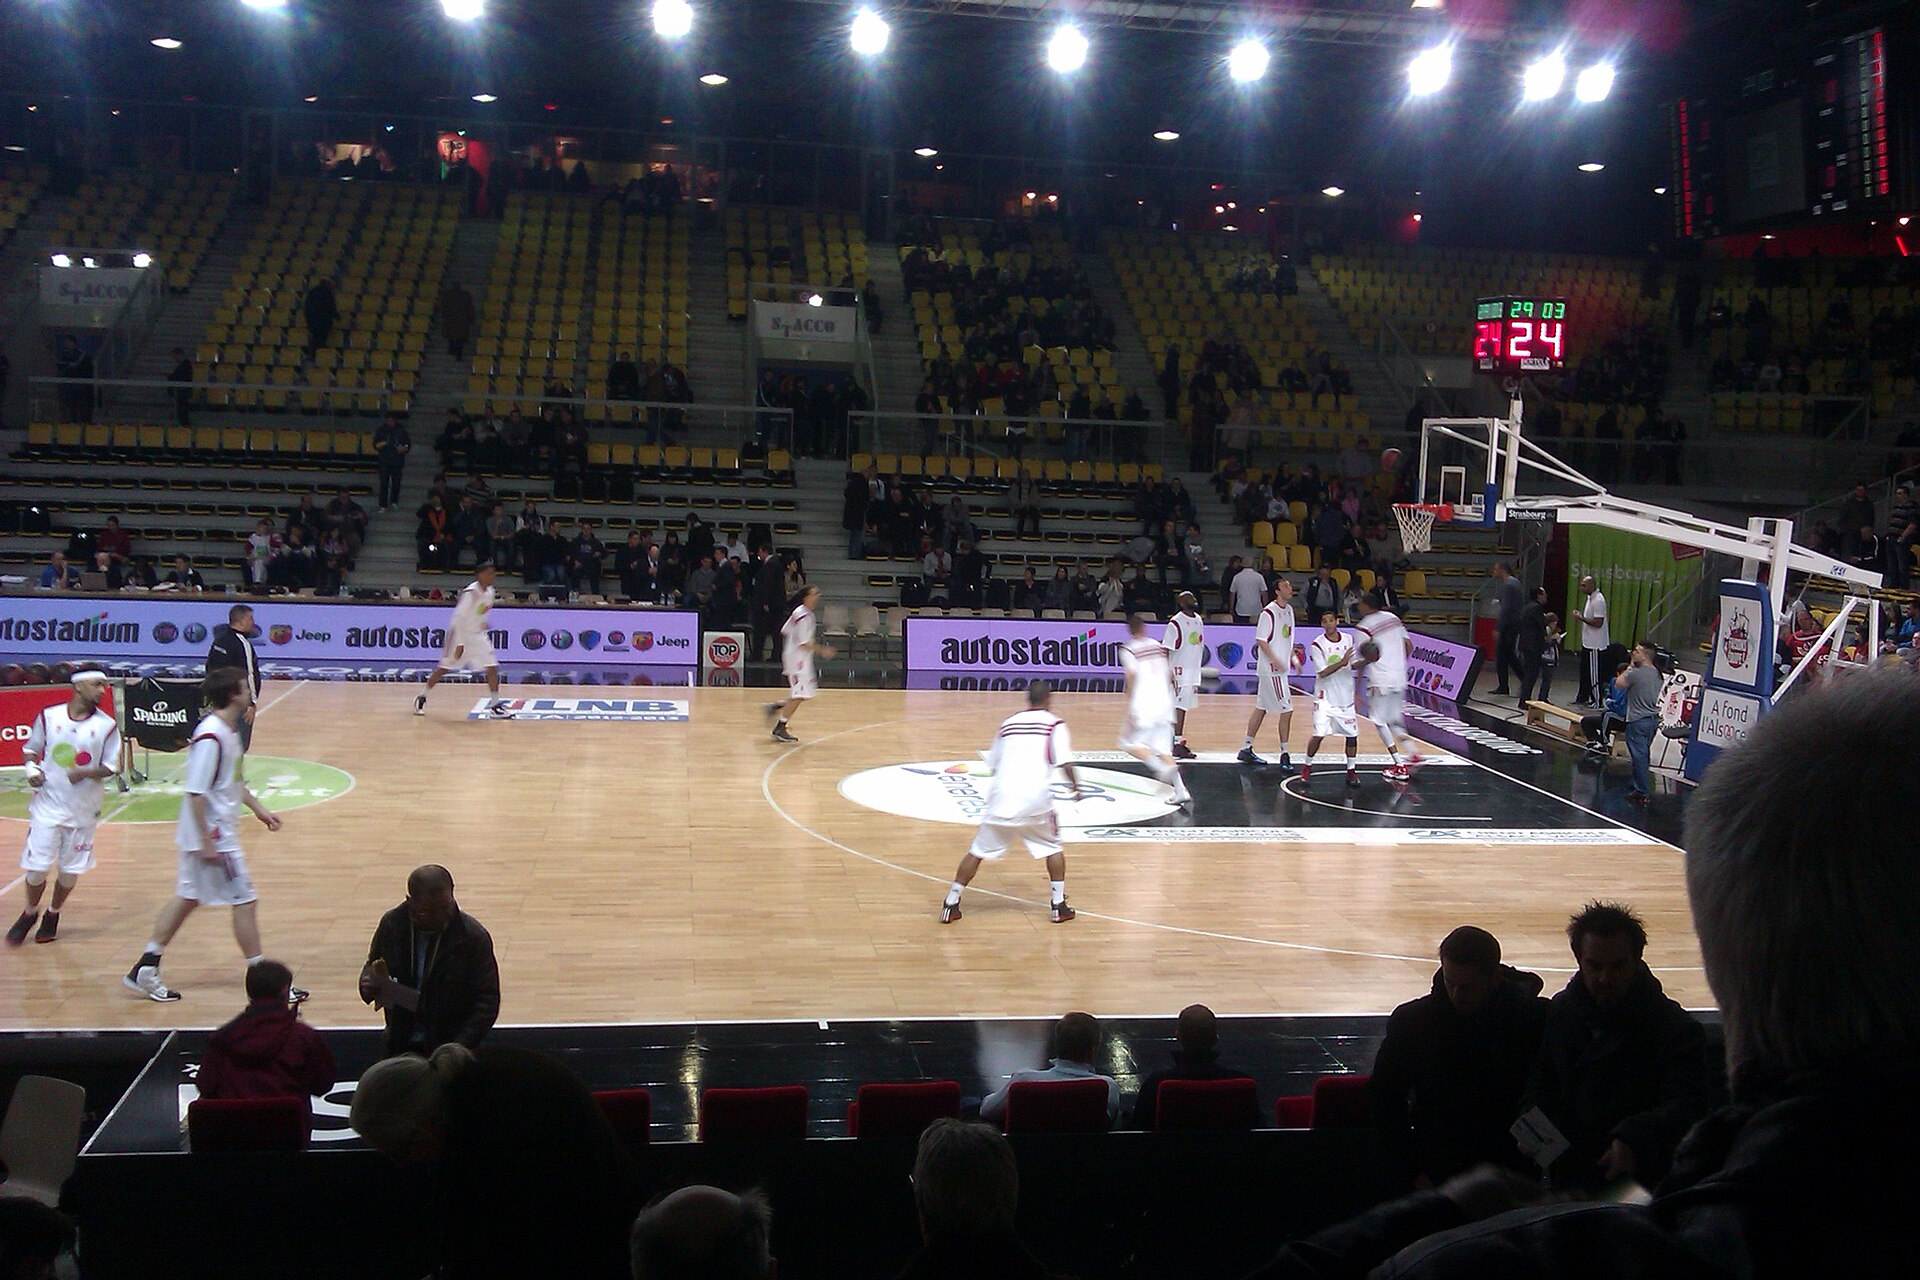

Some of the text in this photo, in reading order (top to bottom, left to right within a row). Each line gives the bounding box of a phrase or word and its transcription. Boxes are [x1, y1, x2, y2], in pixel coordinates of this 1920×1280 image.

[1510, 301, 1534, 318] 29
[1541, 302, 1565, 319] 03
[1474, 321, 1502, 357] 24
[1509, 321, 1563, 358] 24
[0, 612, 140, 643] tostadium
[295, 629, 331, 643] Jeep
[656, 636, 690, 649] Jeep
[711, 644, 738, 657] TOP
[532, 700, 679, 711] LNB
[1711, 699, 1748, 723] A fond
[133, 707, 188, 723] SPALDING
